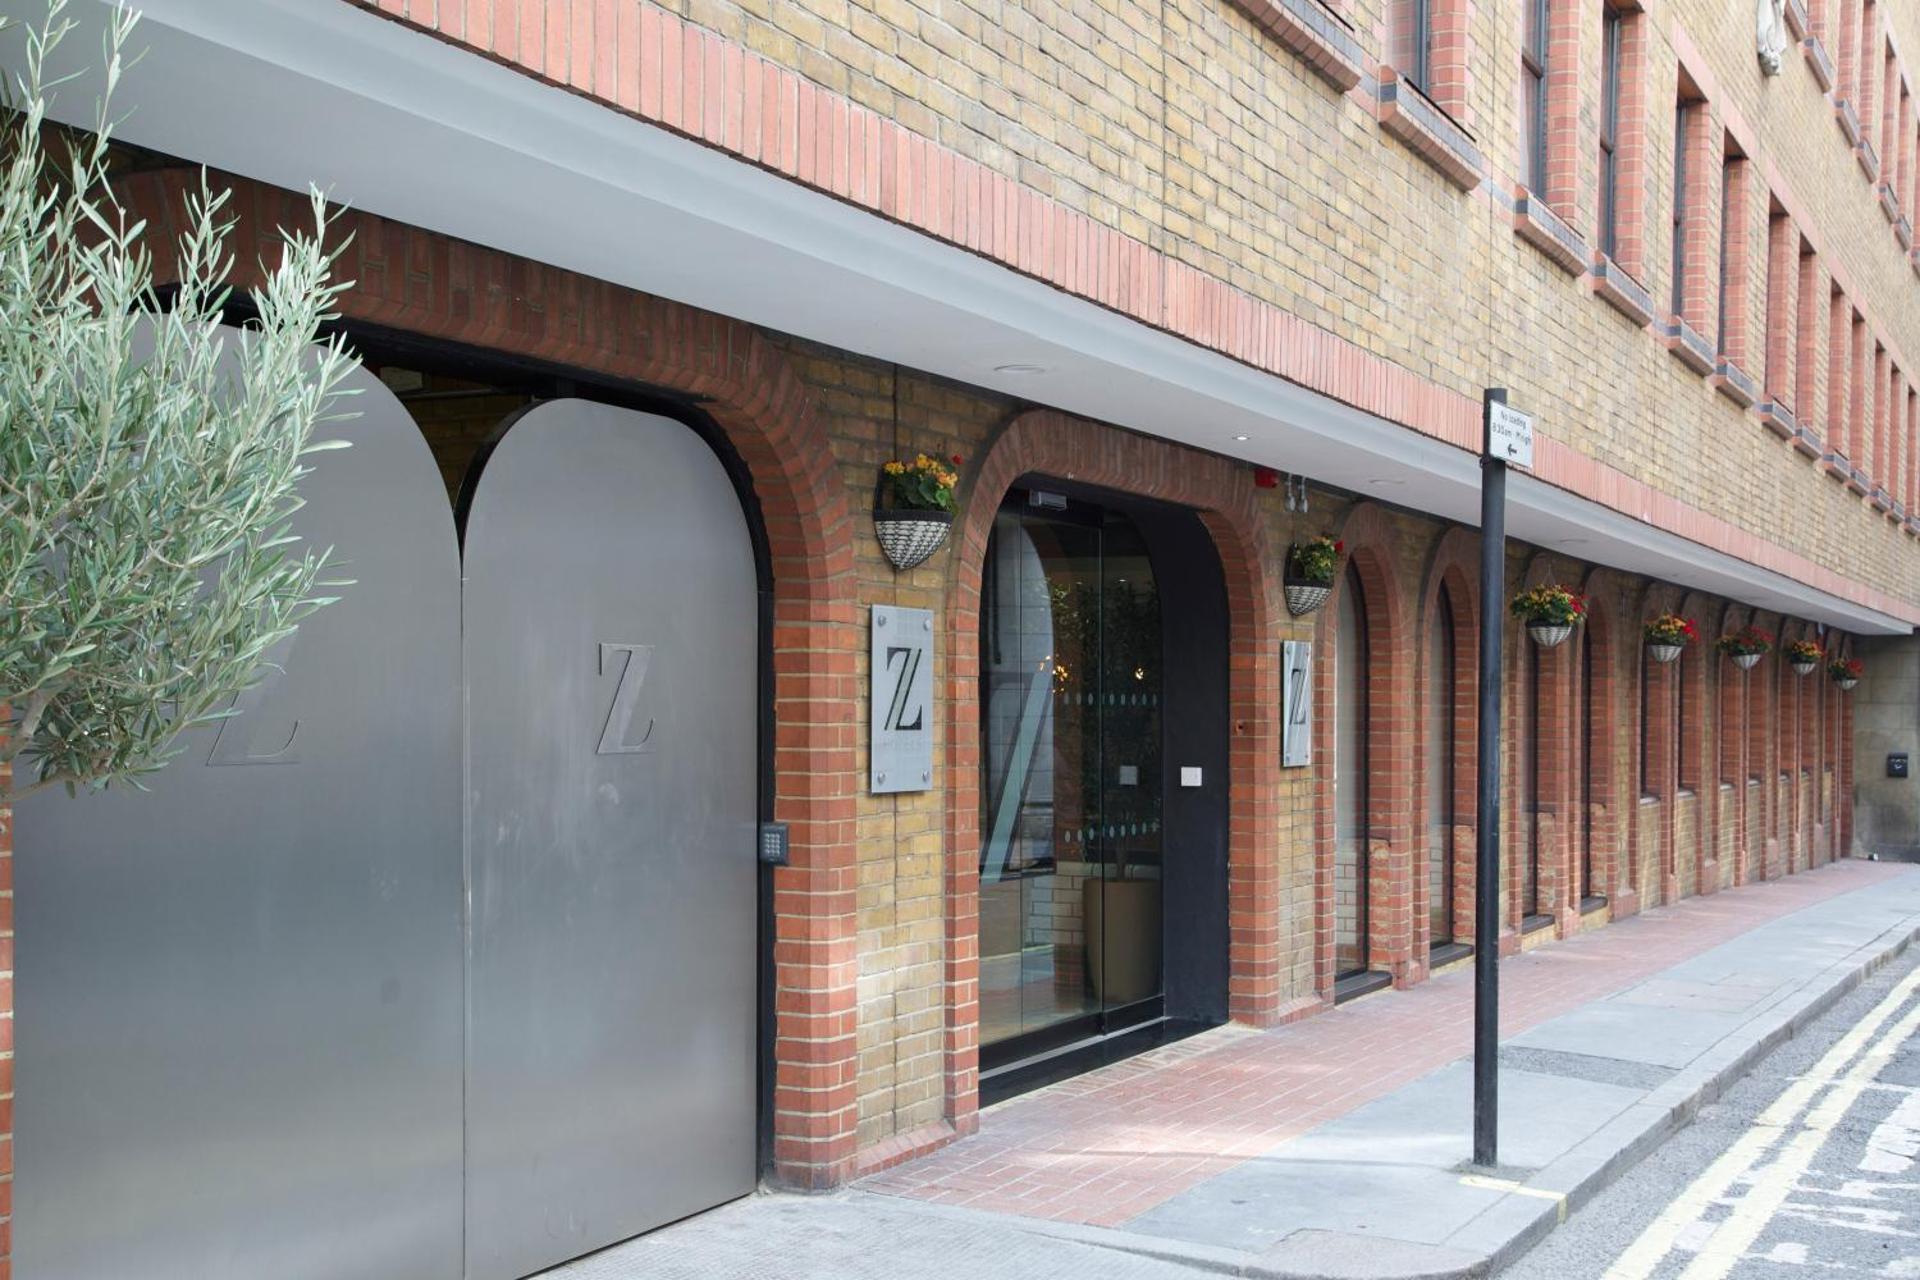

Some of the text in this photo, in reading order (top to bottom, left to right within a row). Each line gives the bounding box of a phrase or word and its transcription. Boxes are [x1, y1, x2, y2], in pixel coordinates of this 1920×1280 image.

[1500, 410, 1508, 421] No
[595, 641, 655, 754] Z
[884, 646, 922, 730] Z
[1289, 667, 1306, 725] Z
